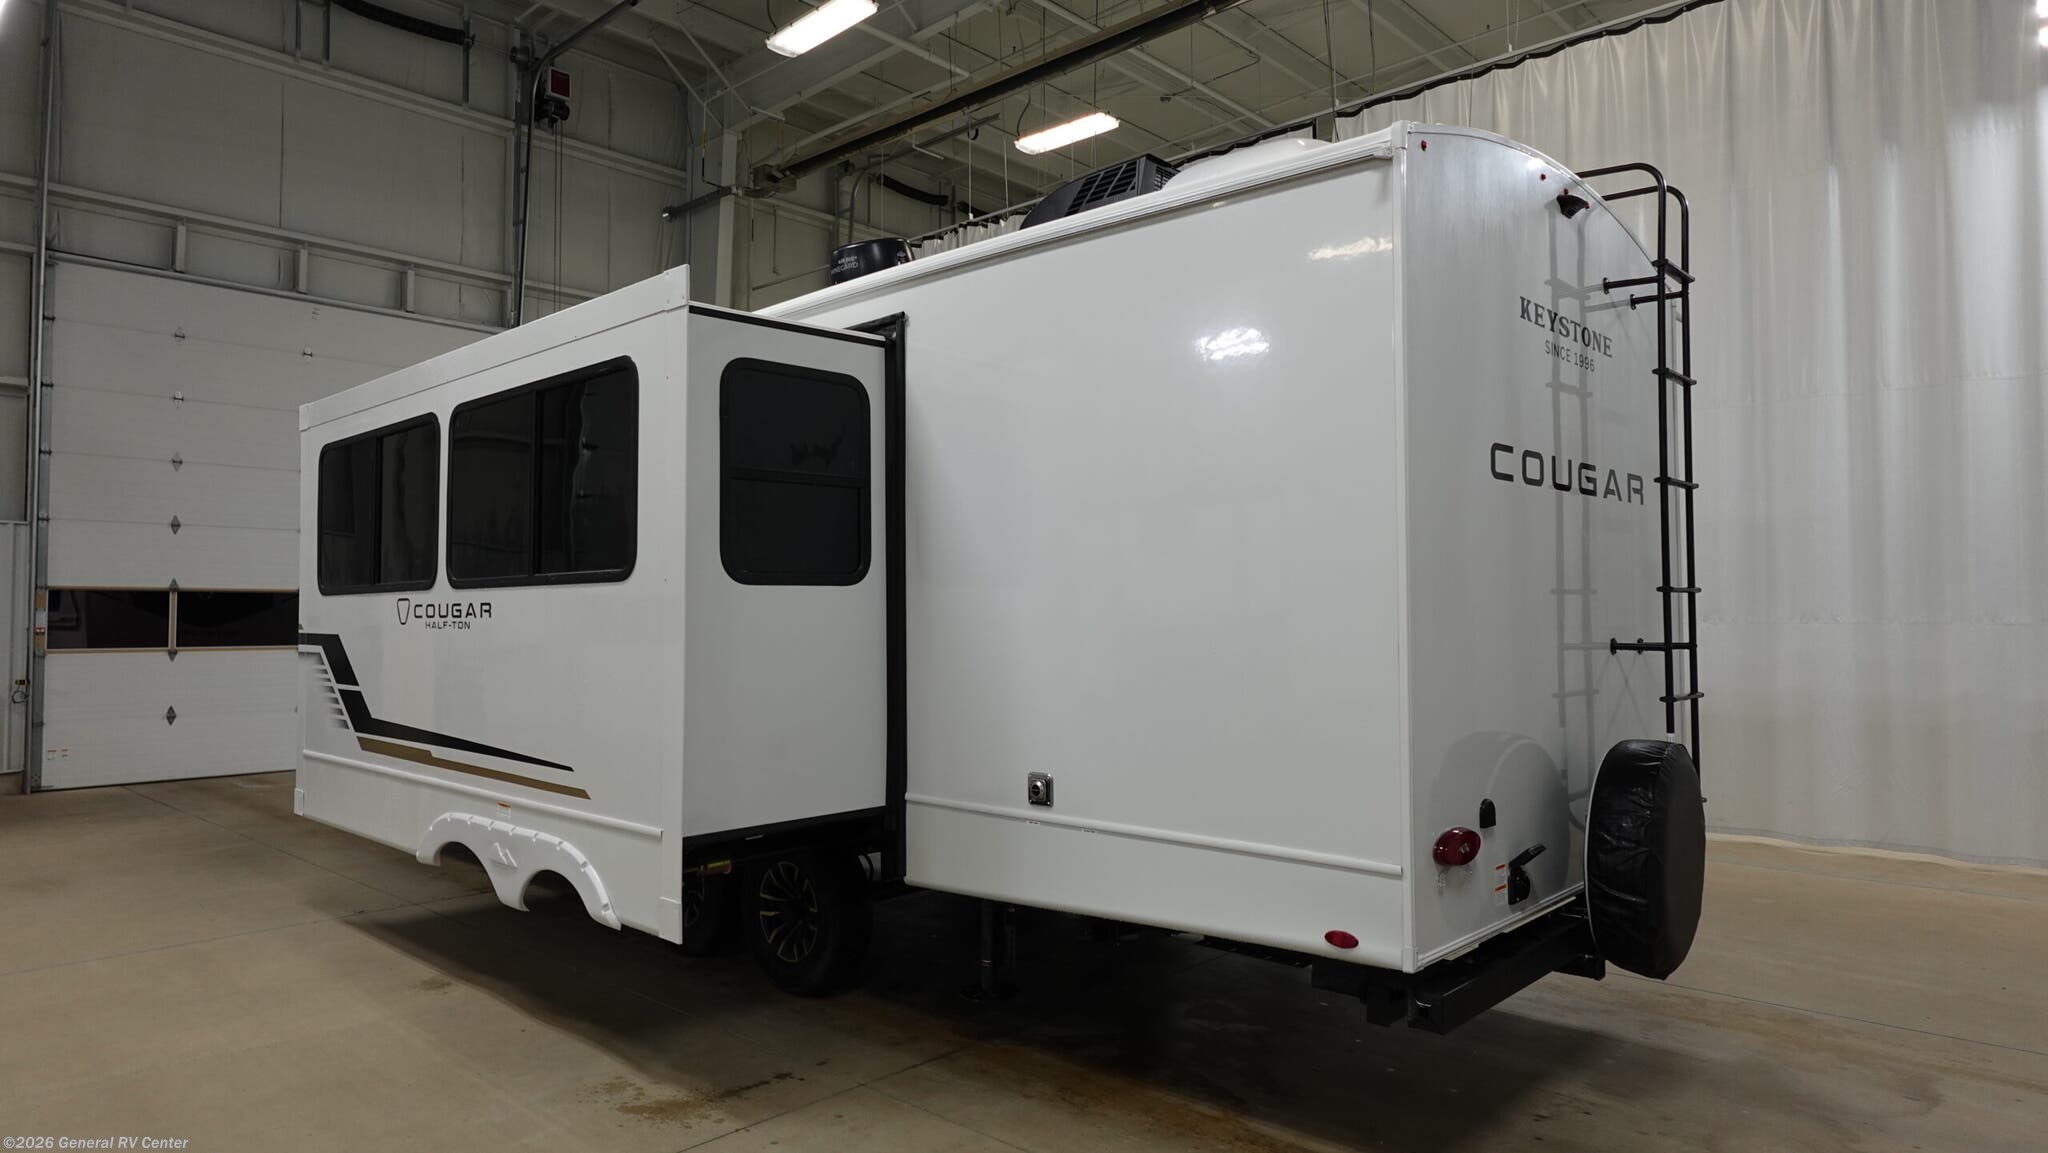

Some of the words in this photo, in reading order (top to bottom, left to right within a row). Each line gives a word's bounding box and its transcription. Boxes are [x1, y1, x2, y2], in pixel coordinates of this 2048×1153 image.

[1519, 295, 1613, 359] KEYSTONE
[1544, 339, 1571, 363] SINCE
[1574, 352, 1596, 372] 1996
[1490, 441, 1645, 506] COUGAR
[413, 602, 492, 619] COUGAR
[425, 621, 471, 630] HALF-TON
